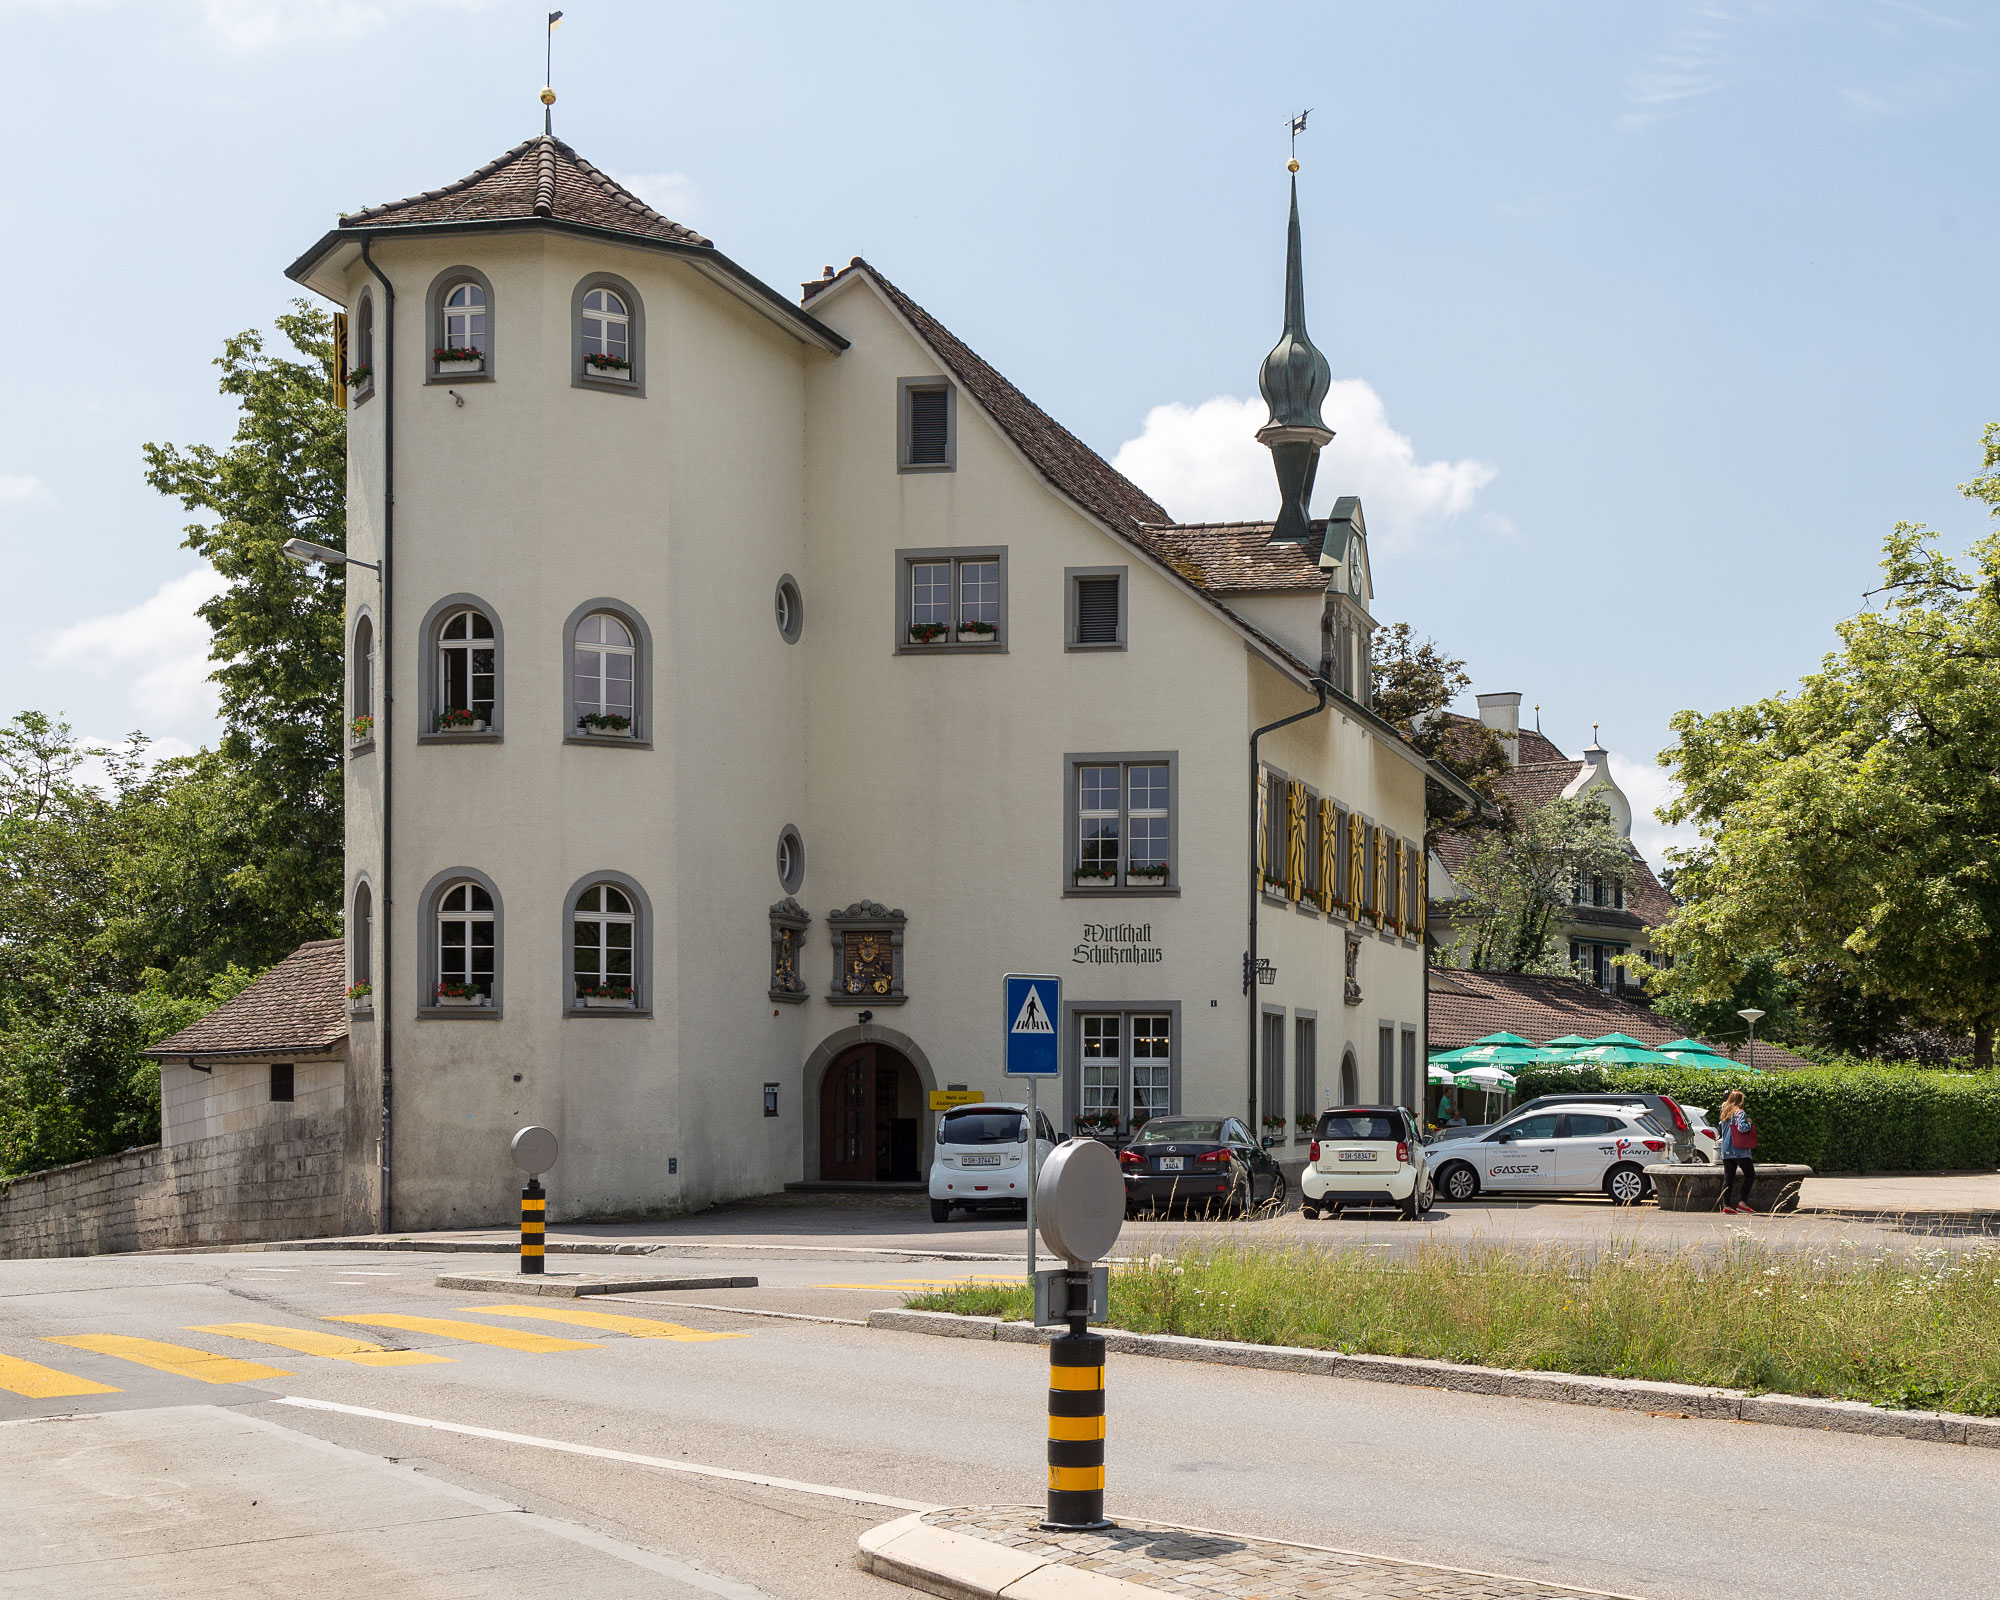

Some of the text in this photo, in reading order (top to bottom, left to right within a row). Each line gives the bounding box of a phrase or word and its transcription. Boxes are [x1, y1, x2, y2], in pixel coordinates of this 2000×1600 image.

[1083, 923, 1152, 944] Wirtschaft
[1072, 944, 1163, 966] Schützenhaus
[1493, 1165, 1539, 1174] GASSER
